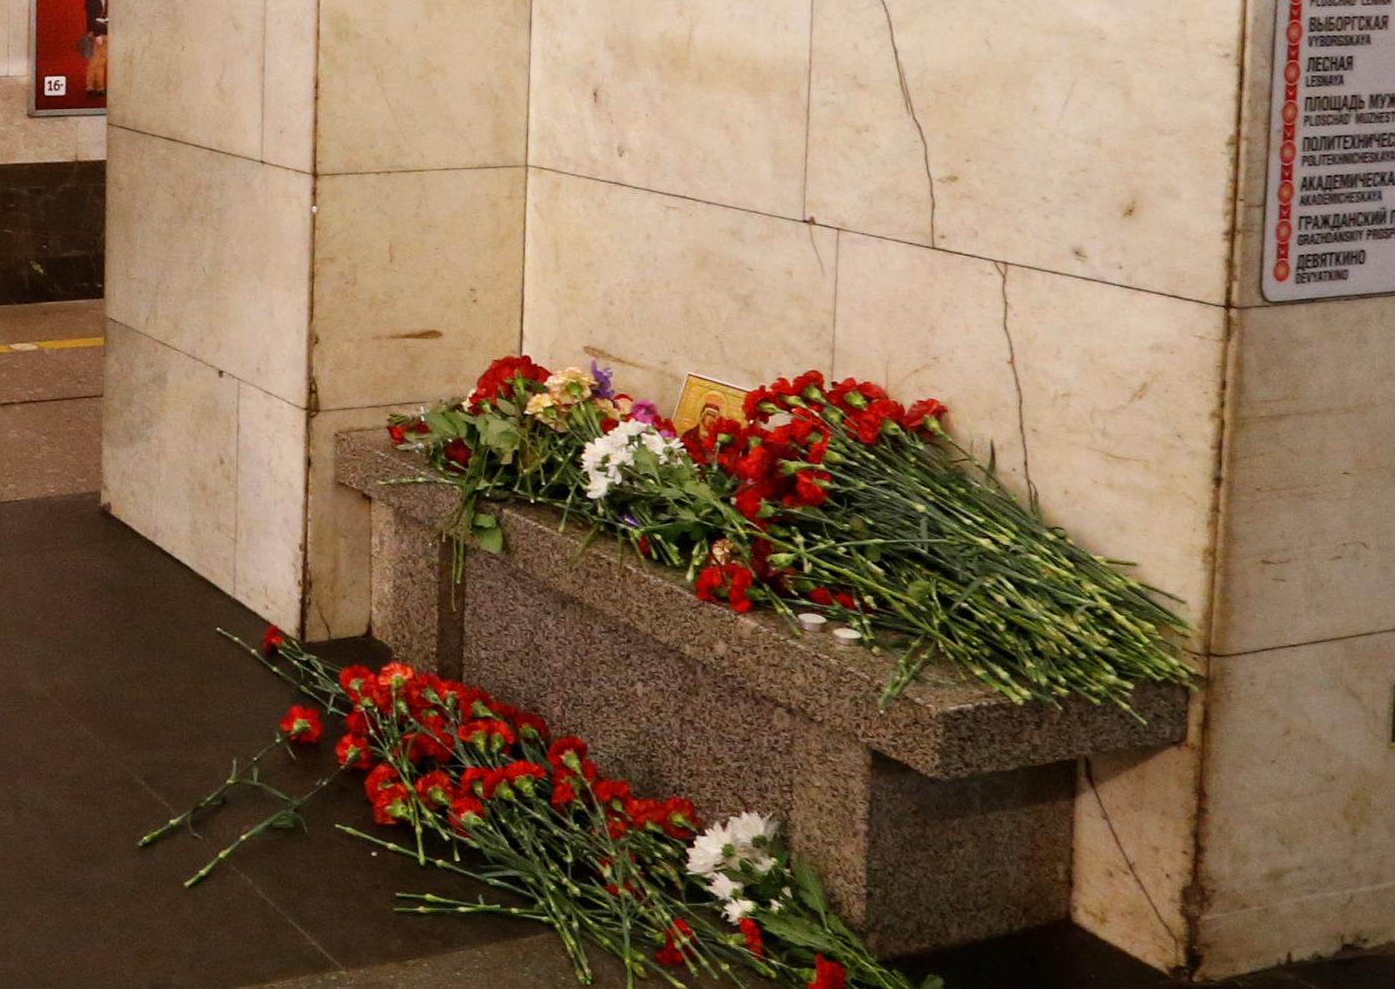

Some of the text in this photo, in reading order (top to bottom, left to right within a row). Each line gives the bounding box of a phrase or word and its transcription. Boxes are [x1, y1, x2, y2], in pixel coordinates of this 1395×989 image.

[1309, 15, 1389, 32] ВЫБОРГСКАЯ
[1306, 56, 1354, 72] ЛЕСНАЯ
[1305, 94, 1365, 112] ПЛОЩАДЬ
[1297, 207, 1386, 231] ГРАЖДАНСКИЙ
[1295, 249, 1366, 273] ДЕВЯТКИНО
